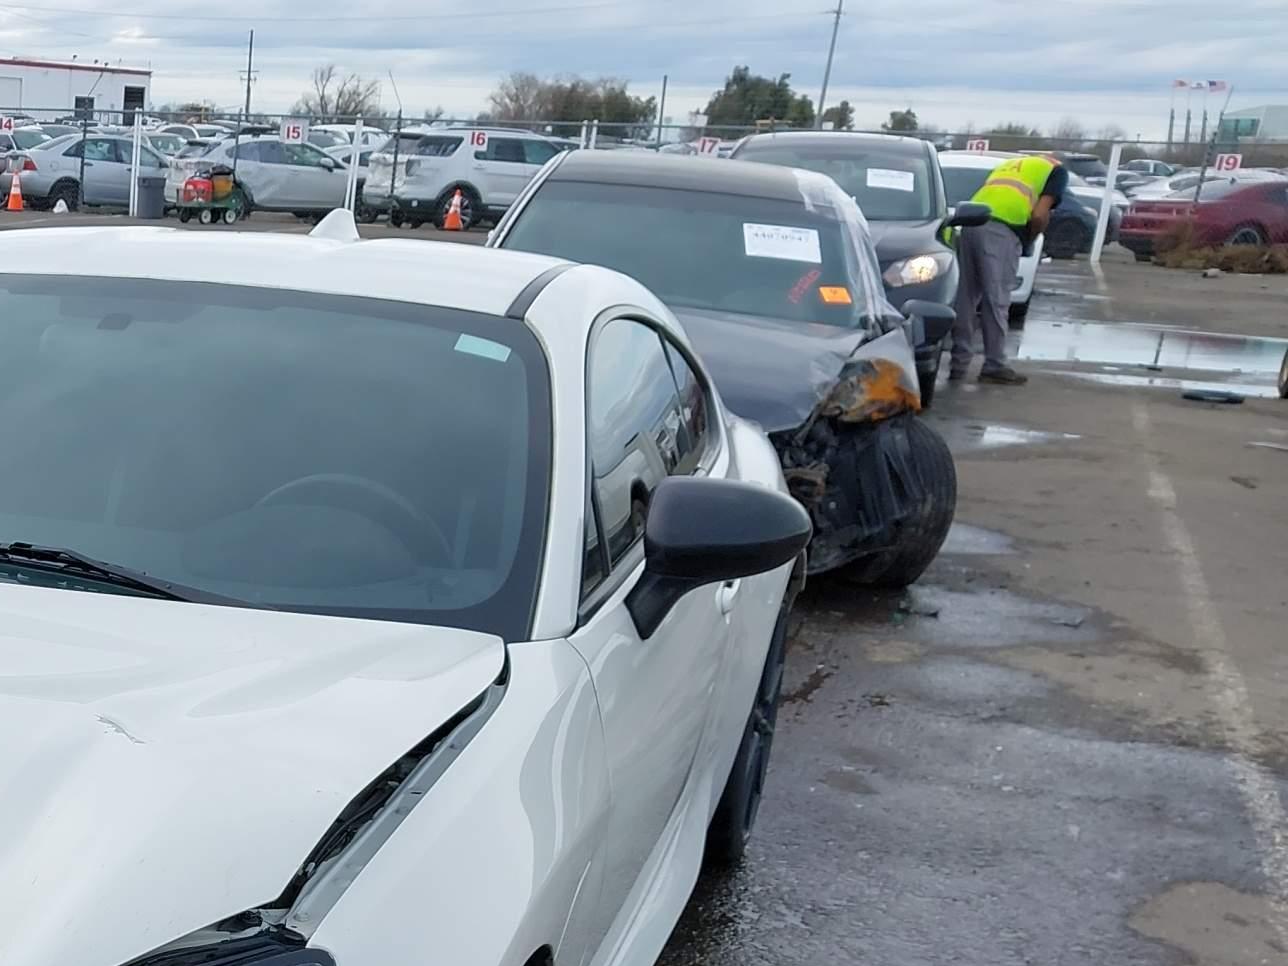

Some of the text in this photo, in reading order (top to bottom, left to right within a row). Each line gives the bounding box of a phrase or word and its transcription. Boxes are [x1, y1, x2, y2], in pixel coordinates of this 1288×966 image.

[0, 117, 12, 130] 14
[286, 126, 301, 139] 15
[471, 131, 486, 145] 16
[700, 138, 718, 153] 17
[1217, 154, 1238, 171] 19
